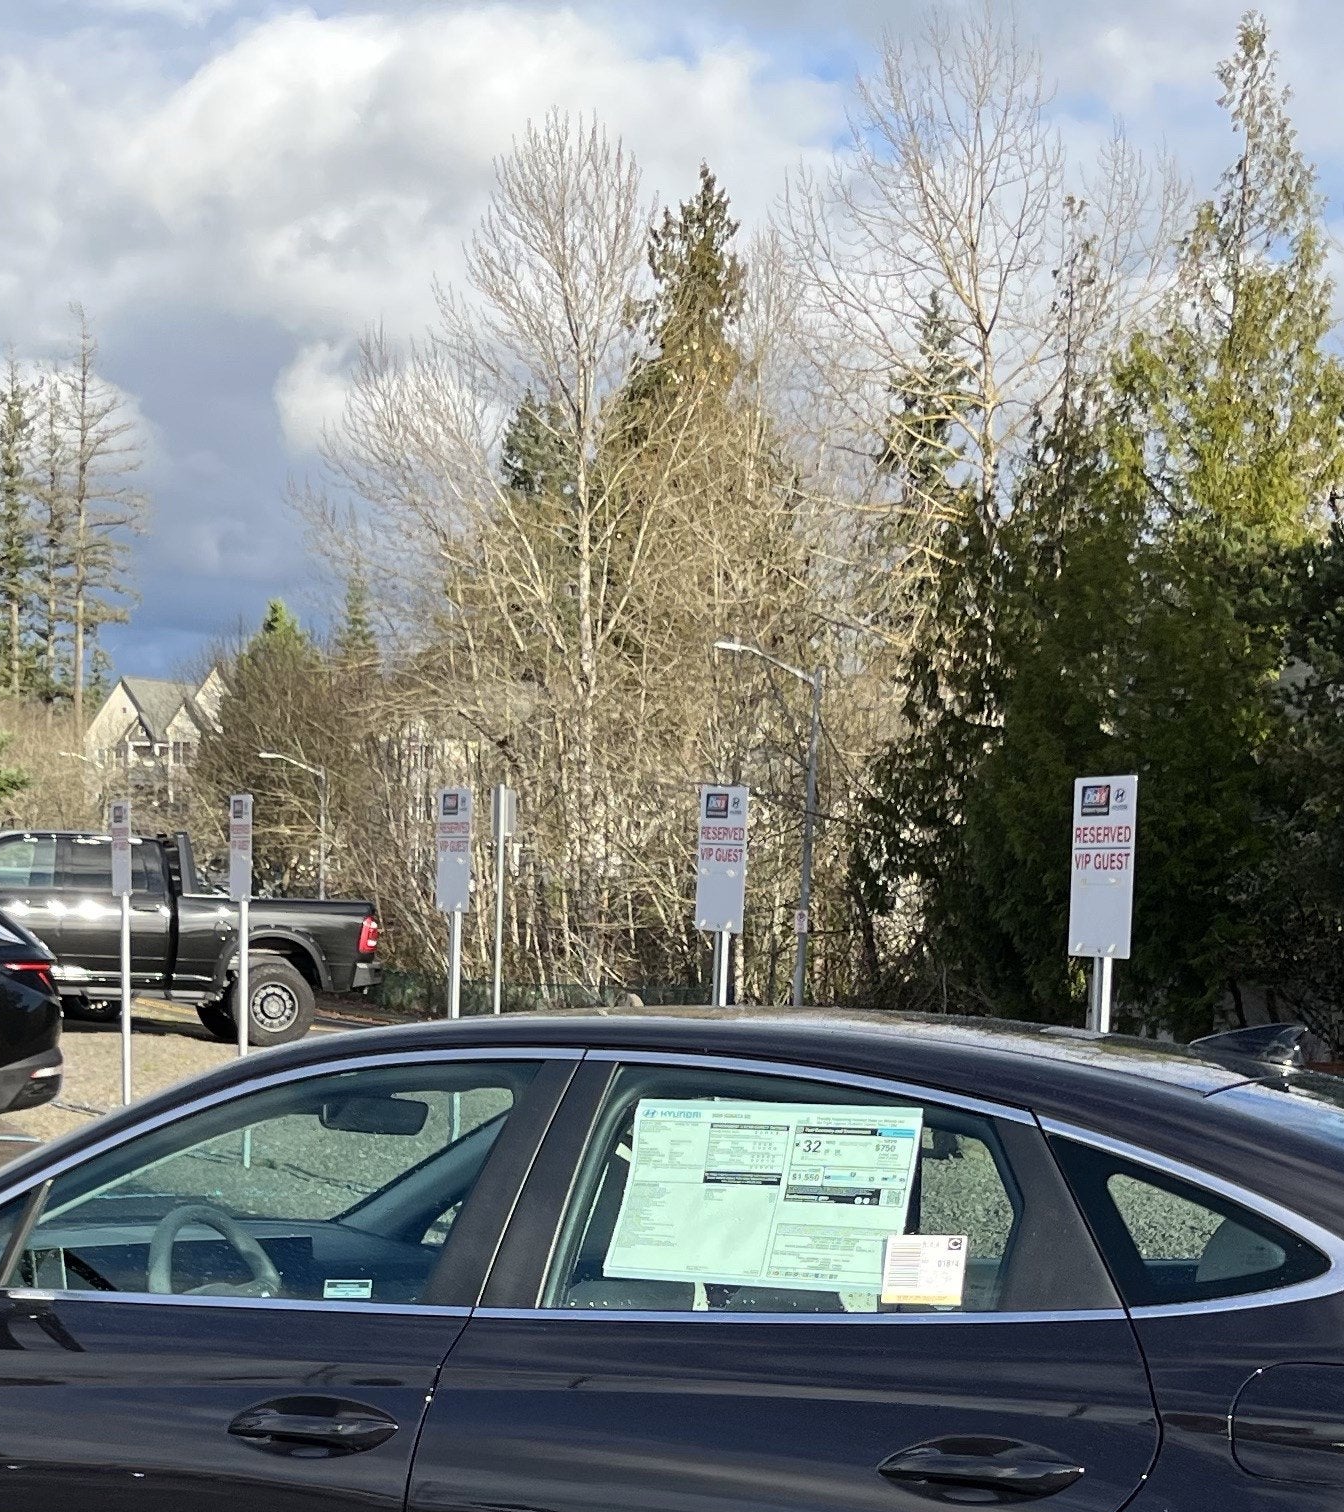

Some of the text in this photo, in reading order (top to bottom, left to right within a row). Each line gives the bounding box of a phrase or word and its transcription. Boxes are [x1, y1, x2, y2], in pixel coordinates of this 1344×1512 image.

[700, 826, 745, 841] RESERVED
[1074, 825, 1132, 844] RESERVED
[715, 848, 744, 862] GUEST
[1074, 853, 1131, 870] VIP GUEST
[802, 1139, 822, 1153] 32
